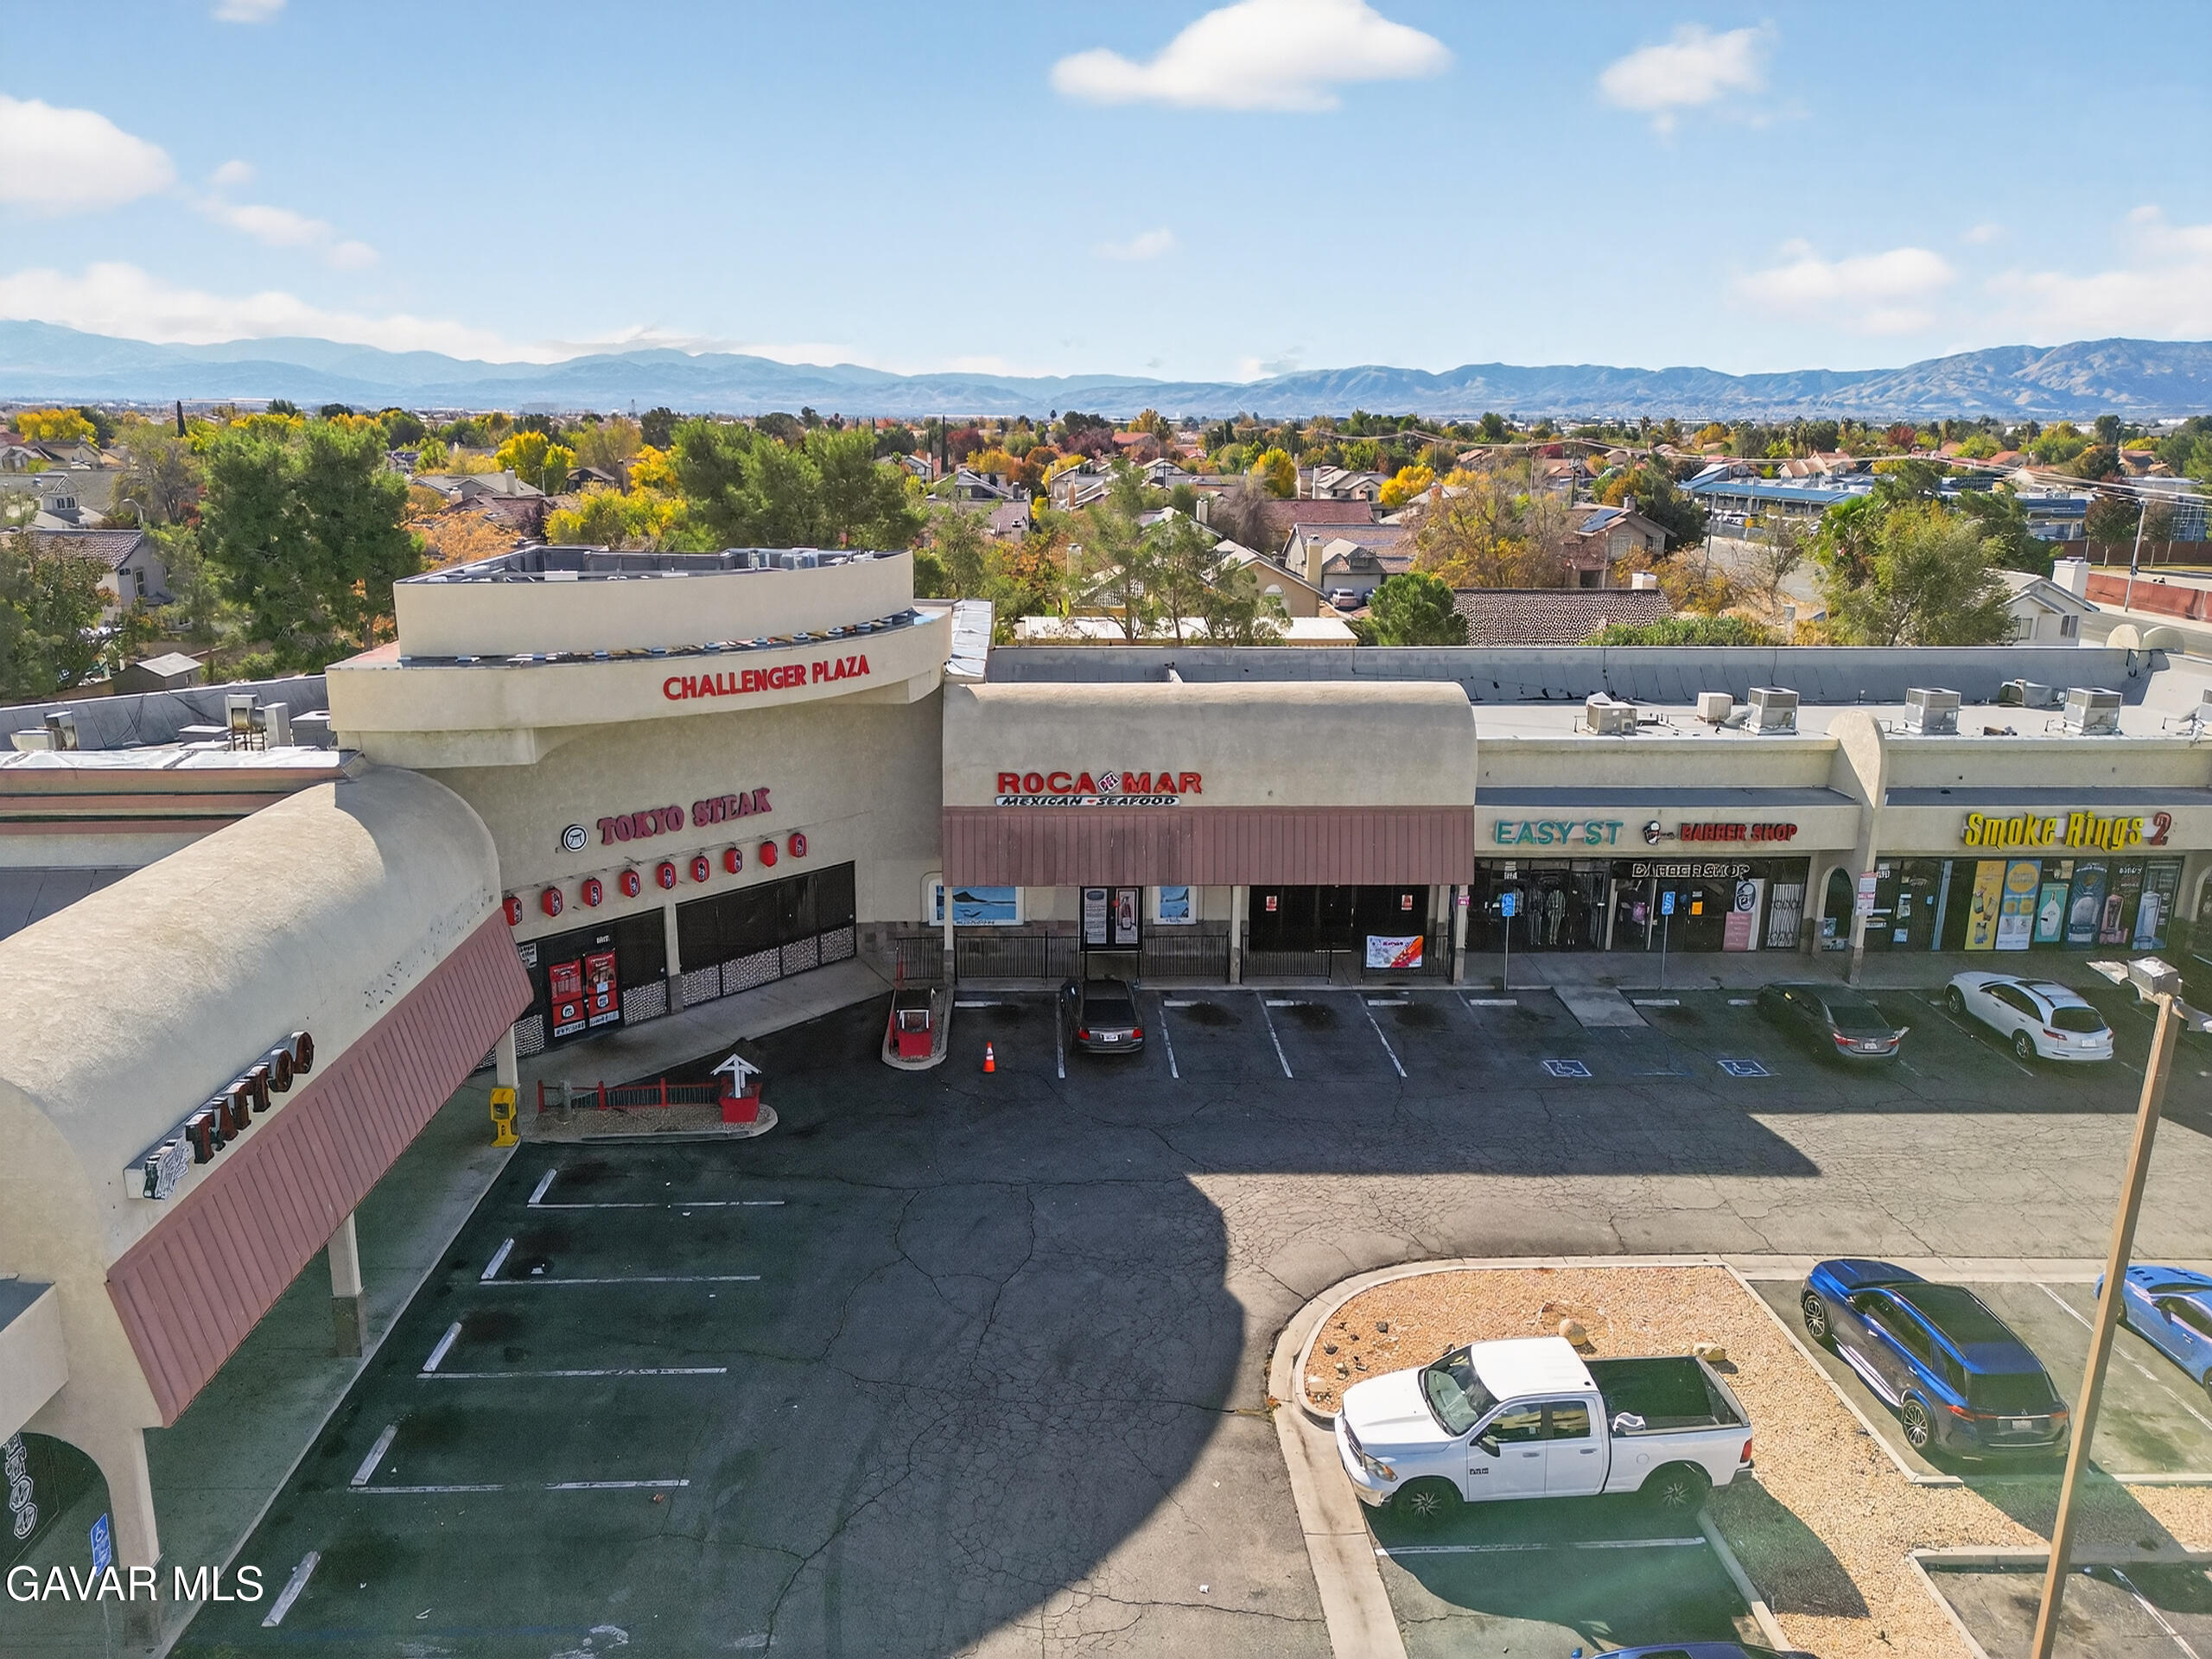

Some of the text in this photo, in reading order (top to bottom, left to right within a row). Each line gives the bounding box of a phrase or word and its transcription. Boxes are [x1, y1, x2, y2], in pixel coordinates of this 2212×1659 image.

[663, 654, 870, 700] CHALLENGER PLAZA
[997, 772, 1097, 794] ROCA
[1122, 772, 1202, 794] MAR
[1001, 796, 1082, 805] MEXICAN
[1096, 796, 1176, 805] SEAFOOD
[597, 787, 772, 846] TOKYO STEAK
[1496, 821, 1624, 845] EASY ST
[1680, 823, 1797, 842] BARBER SHOP
[1964, 810, 2173, 852] Smoke Rings 2
[1703, 863, 1750, 878] SHOP
[185, 1031, 315, 1165] TATTOO
